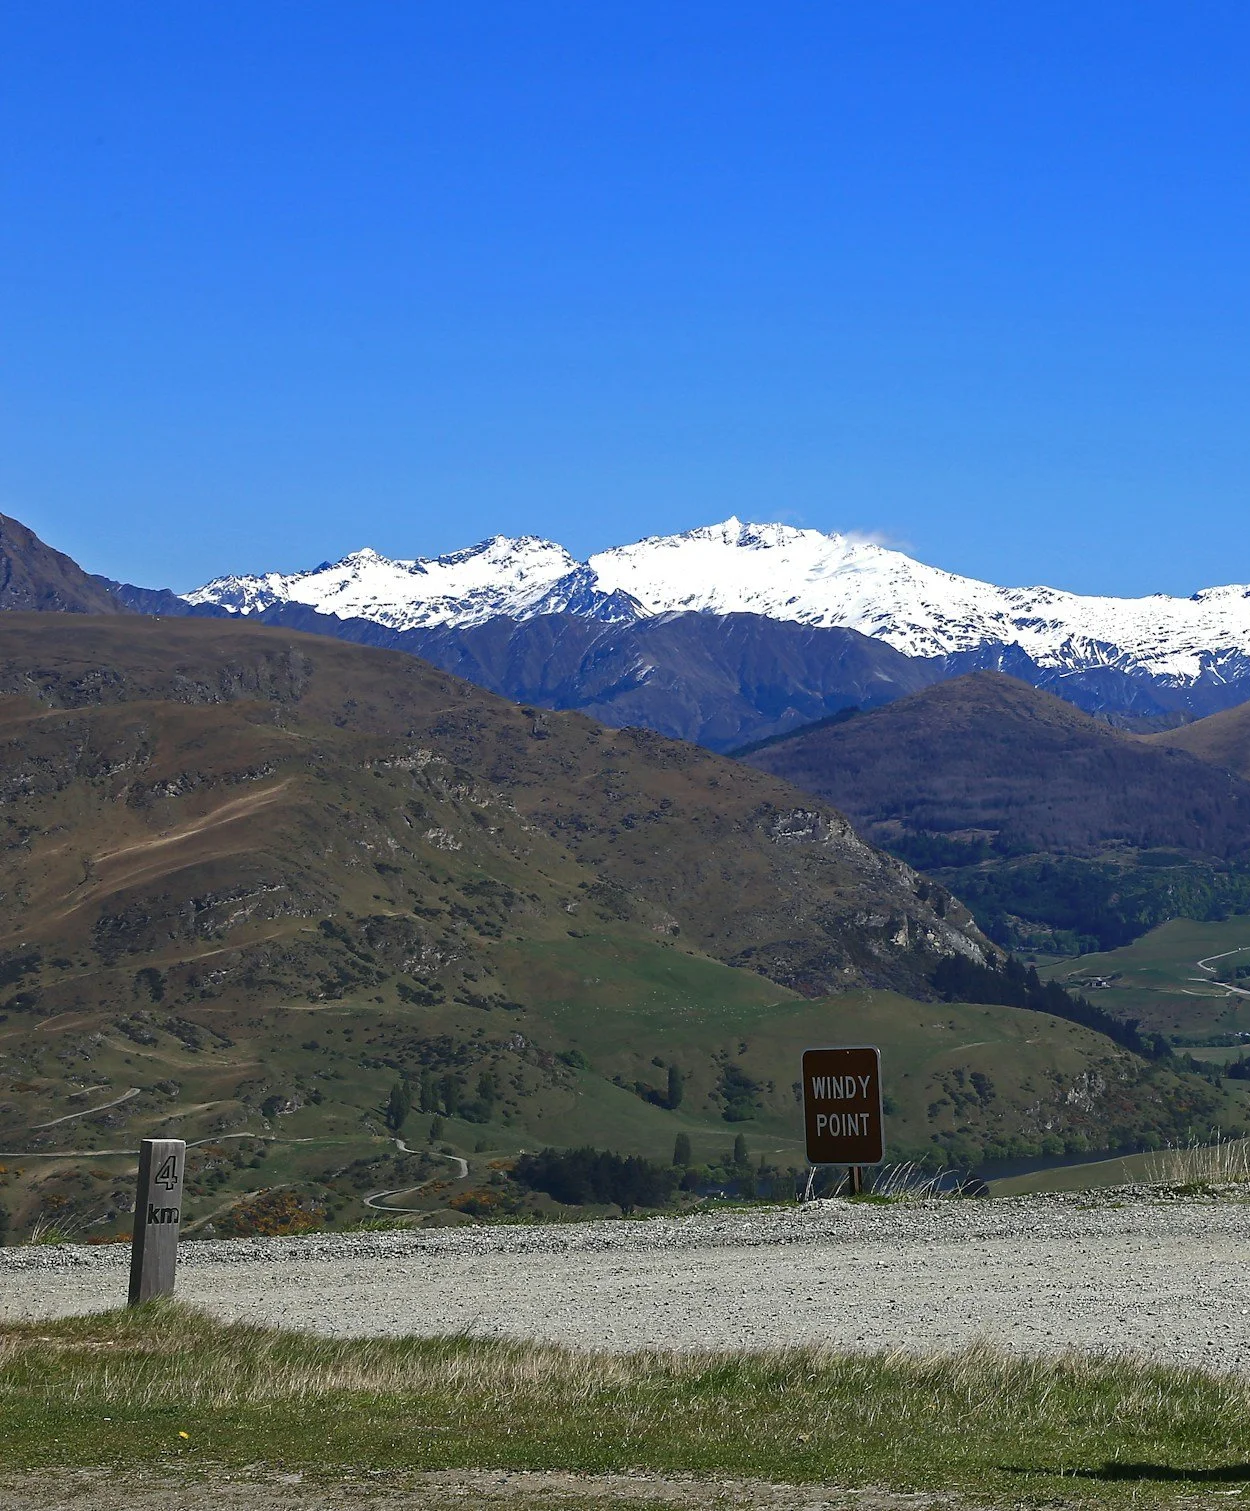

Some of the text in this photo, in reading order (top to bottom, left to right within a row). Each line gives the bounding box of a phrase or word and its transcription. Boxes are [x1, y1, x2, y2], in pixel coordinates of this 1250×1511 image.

[812, 1075, 870, 1099] WINDY
[816, 1113, 870, 1137] POINT
[155, 1155, 178, 1190] 4
[147, 1203, 179, 1224] km
